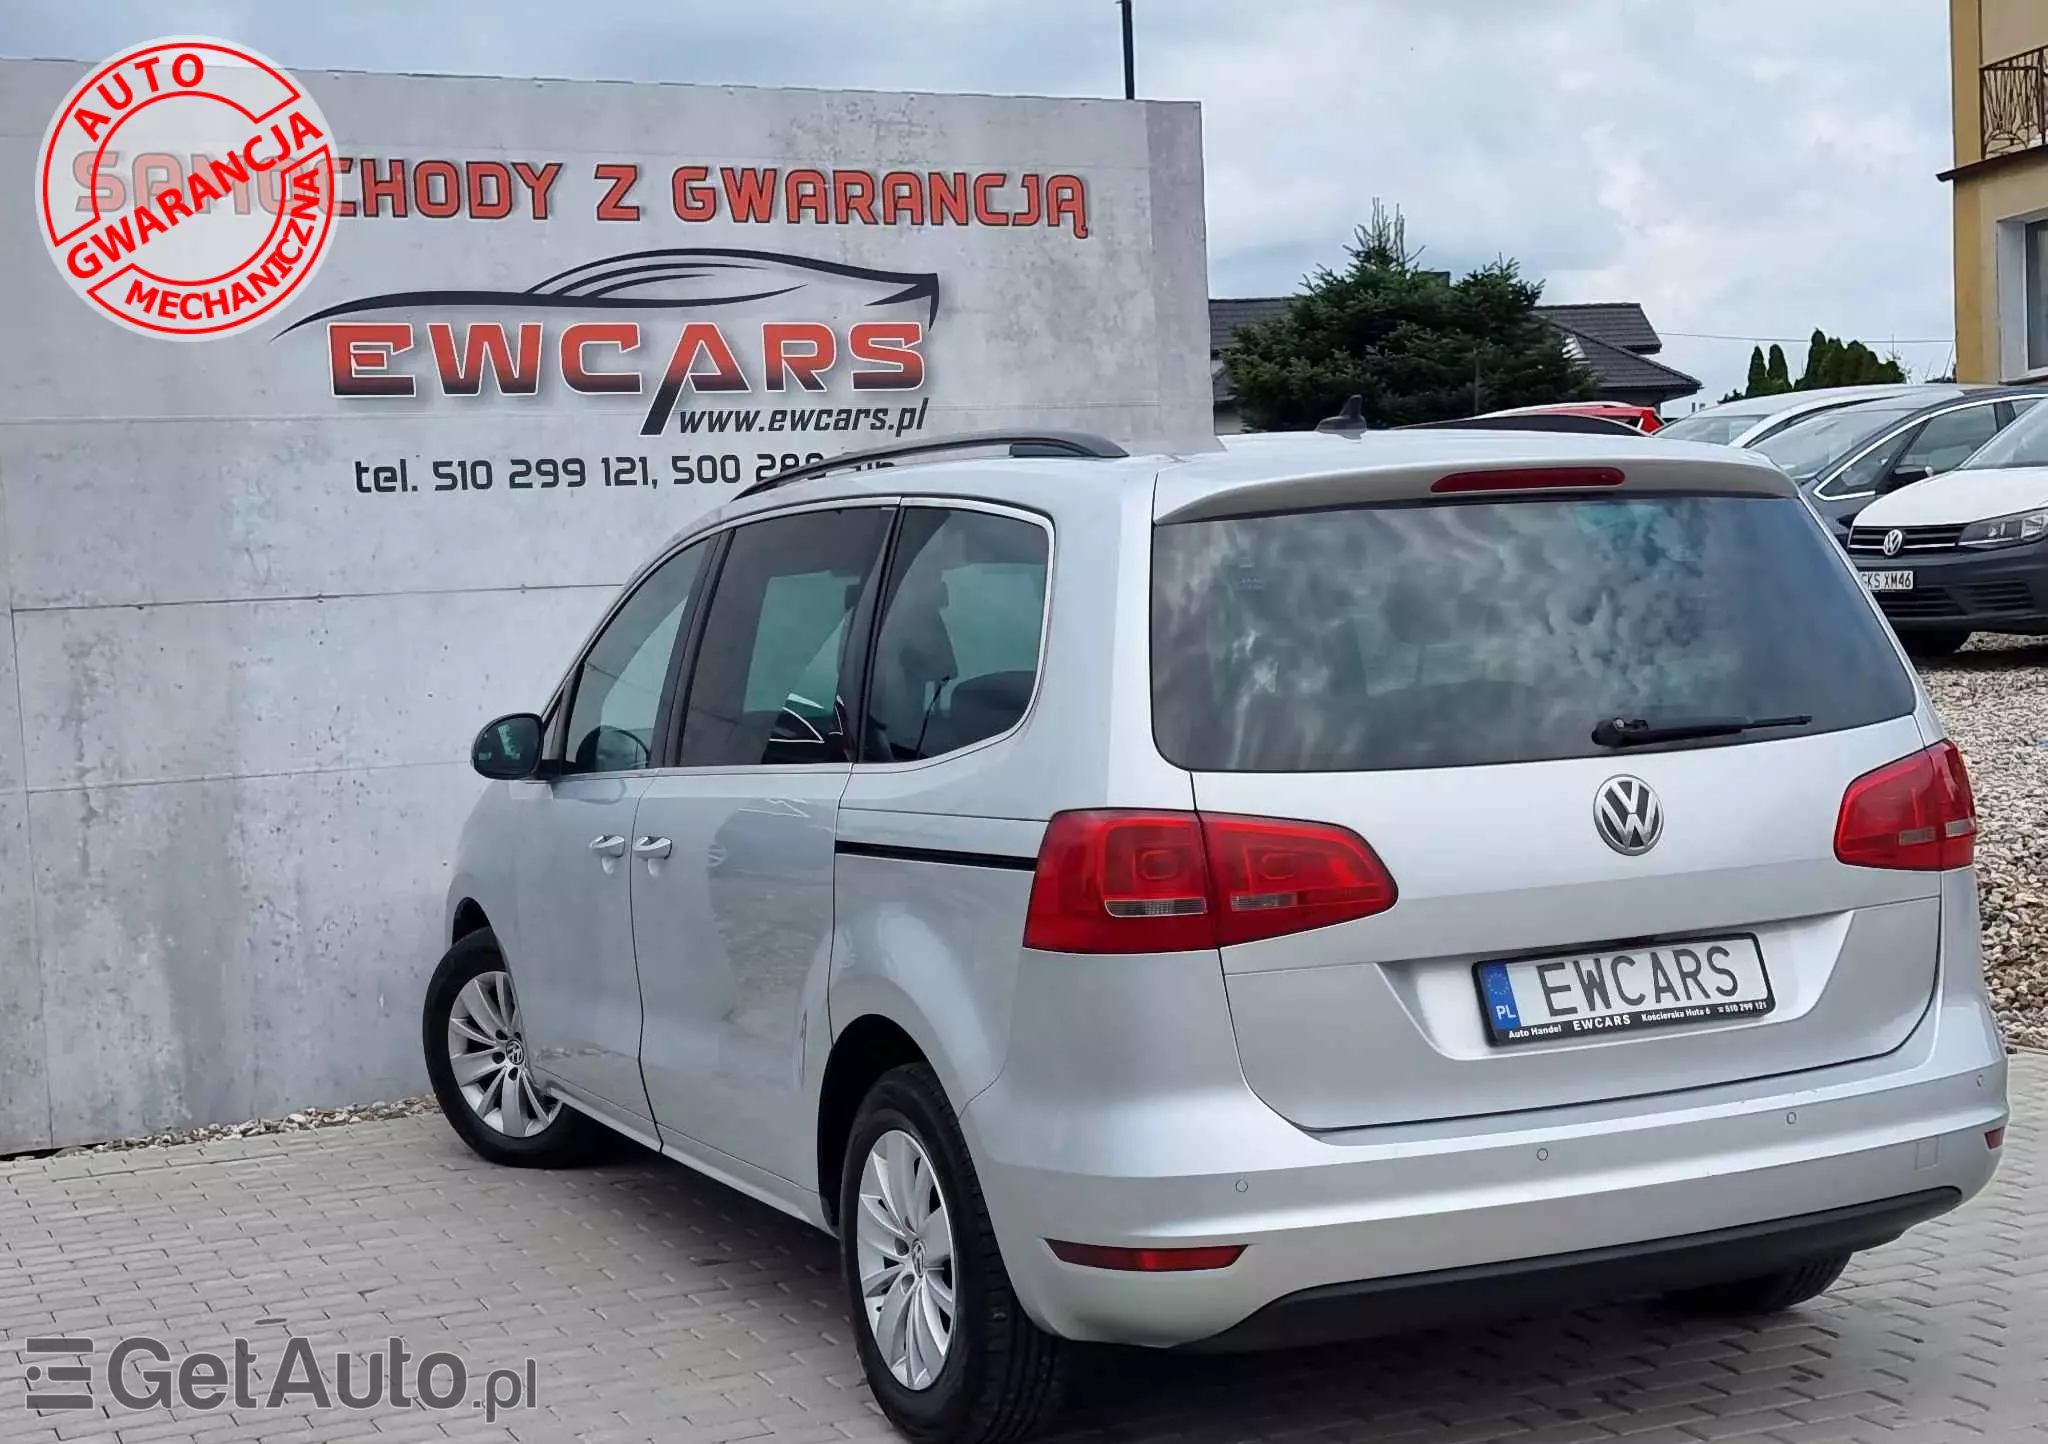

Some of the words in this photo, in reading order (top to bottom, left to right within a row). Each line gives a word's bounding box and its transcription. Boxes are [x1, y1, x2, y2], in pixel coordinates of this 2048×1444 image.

[594, 163, 641, 221] Z
[672, 165, 1089, 240] GWARANCJĄ
[327, 321, 925, 437] EWCARS
[680, 397, 930, 438] www.ewcars.pl
[354, 458, 418, 493] tel.
[432, 460, 493, 491] 510
[508, 457, 586, 488] 299
[601, 456, 658, 489] 121,
[671, 454, 741, 485] 500
[1496, 1004, 1517, 1020] PL
[1536, 945, 1739, 1017] EWCARS
[1508, 1029, 1530, 1039] Auto
[1531, 1025, 1562, 1036] Handel
[1572, 1014, 1631, 1031] EWCARS
[1686, 1008, 1705, 1018] Huta
